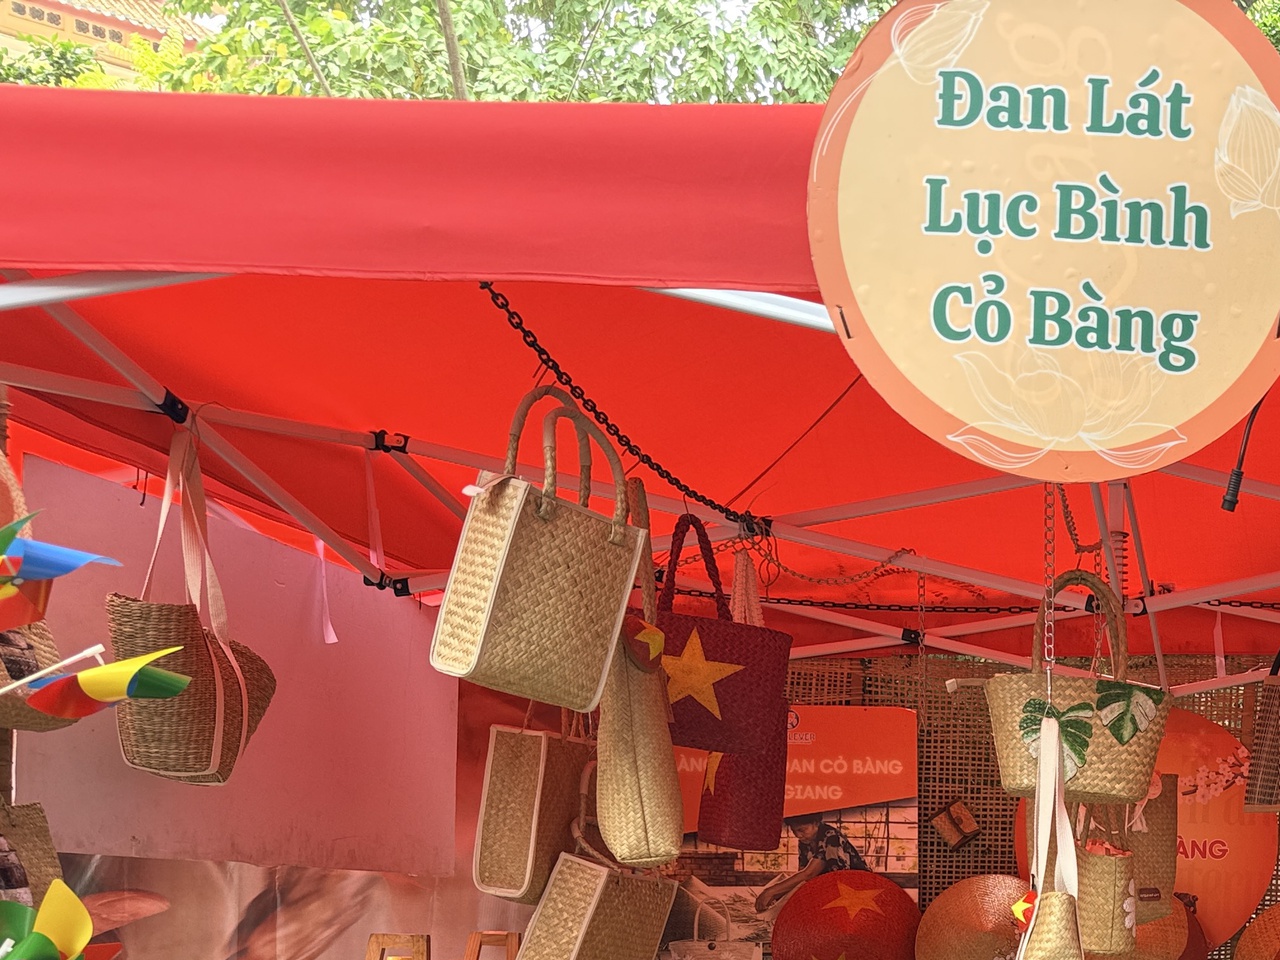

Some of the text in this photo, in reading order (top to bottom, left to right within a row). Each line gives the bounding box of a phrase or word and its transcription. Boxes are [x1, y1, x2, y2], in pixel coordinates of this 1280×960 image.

[937, 68, 1193, 139] Đan Lát
[923, 173, 1210, 254] Lục Bình
[932, 273, 1198, 373] Cỏ Bàng
[819, 755, 904, 775] CỎ BÀNG
